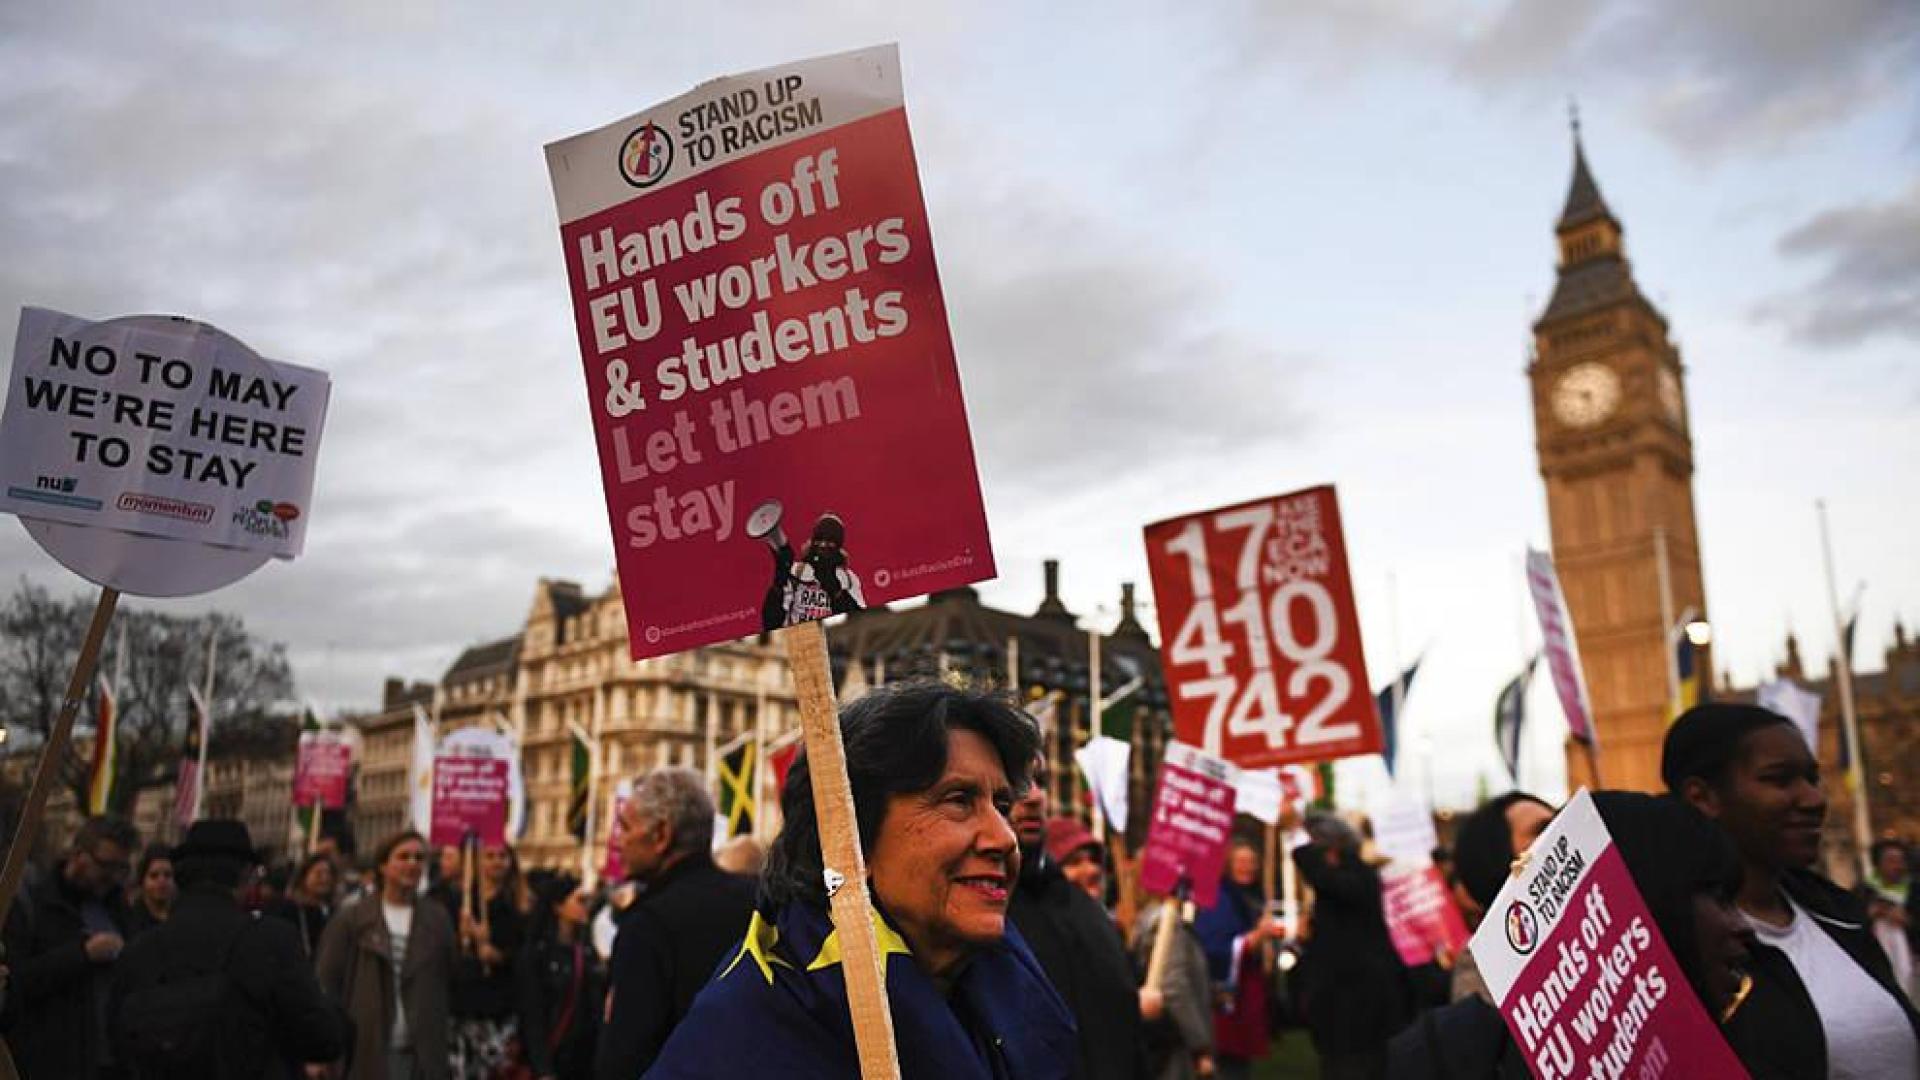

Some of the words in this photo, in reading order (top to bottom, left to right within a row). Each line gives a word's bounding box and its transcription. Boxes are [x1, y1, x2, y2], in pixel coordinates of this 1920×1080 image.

[679, 88, 759, 138] STAND
[764, 75, 802, 106] UP
[683, 133, 716, 168] TO
[721, 96, 823, 154] RACISM
[579, 191, 748, 290] Hands
[760, 148, 840, 226] off
[589, 278, 663, 355] EU
[674, 217, 910, 323] workers
[49, 336, 118, 377] NO
[135, 352, 194, 390] TO
[208, 368, 299, 412] MAY
[606, 358, 646, 417] &
[657, 288, 908, 401] students
[24, 376, 176, 432] WE'RE
[190, 407, 306, 457] HERE
[71, 431, 130, 468] TO
[147, 445, 257, 490] STAY
[612, 411, 702, 484] Let
[710, 376, 862, 453] them
[627, 480, 736, 549] stay
[1166, 506, 1274, 597] 17
[1171, 581, 1338, 676] 410
[1179, 660, 1362, 760] 742
[1528, 854, 1557, 905] STAND
[1553, 835, 1568, 863] UP
[1538, 897, 1556, 925] TO
[1551, 849, 1585, 907] RACISM
[1512, 937, 1589, 1052] Hands
[1580, 883, 1612, 951] off
[1571, 916, 1650, 1045] workers
[1586, 965, 1668, 1080] tudents
